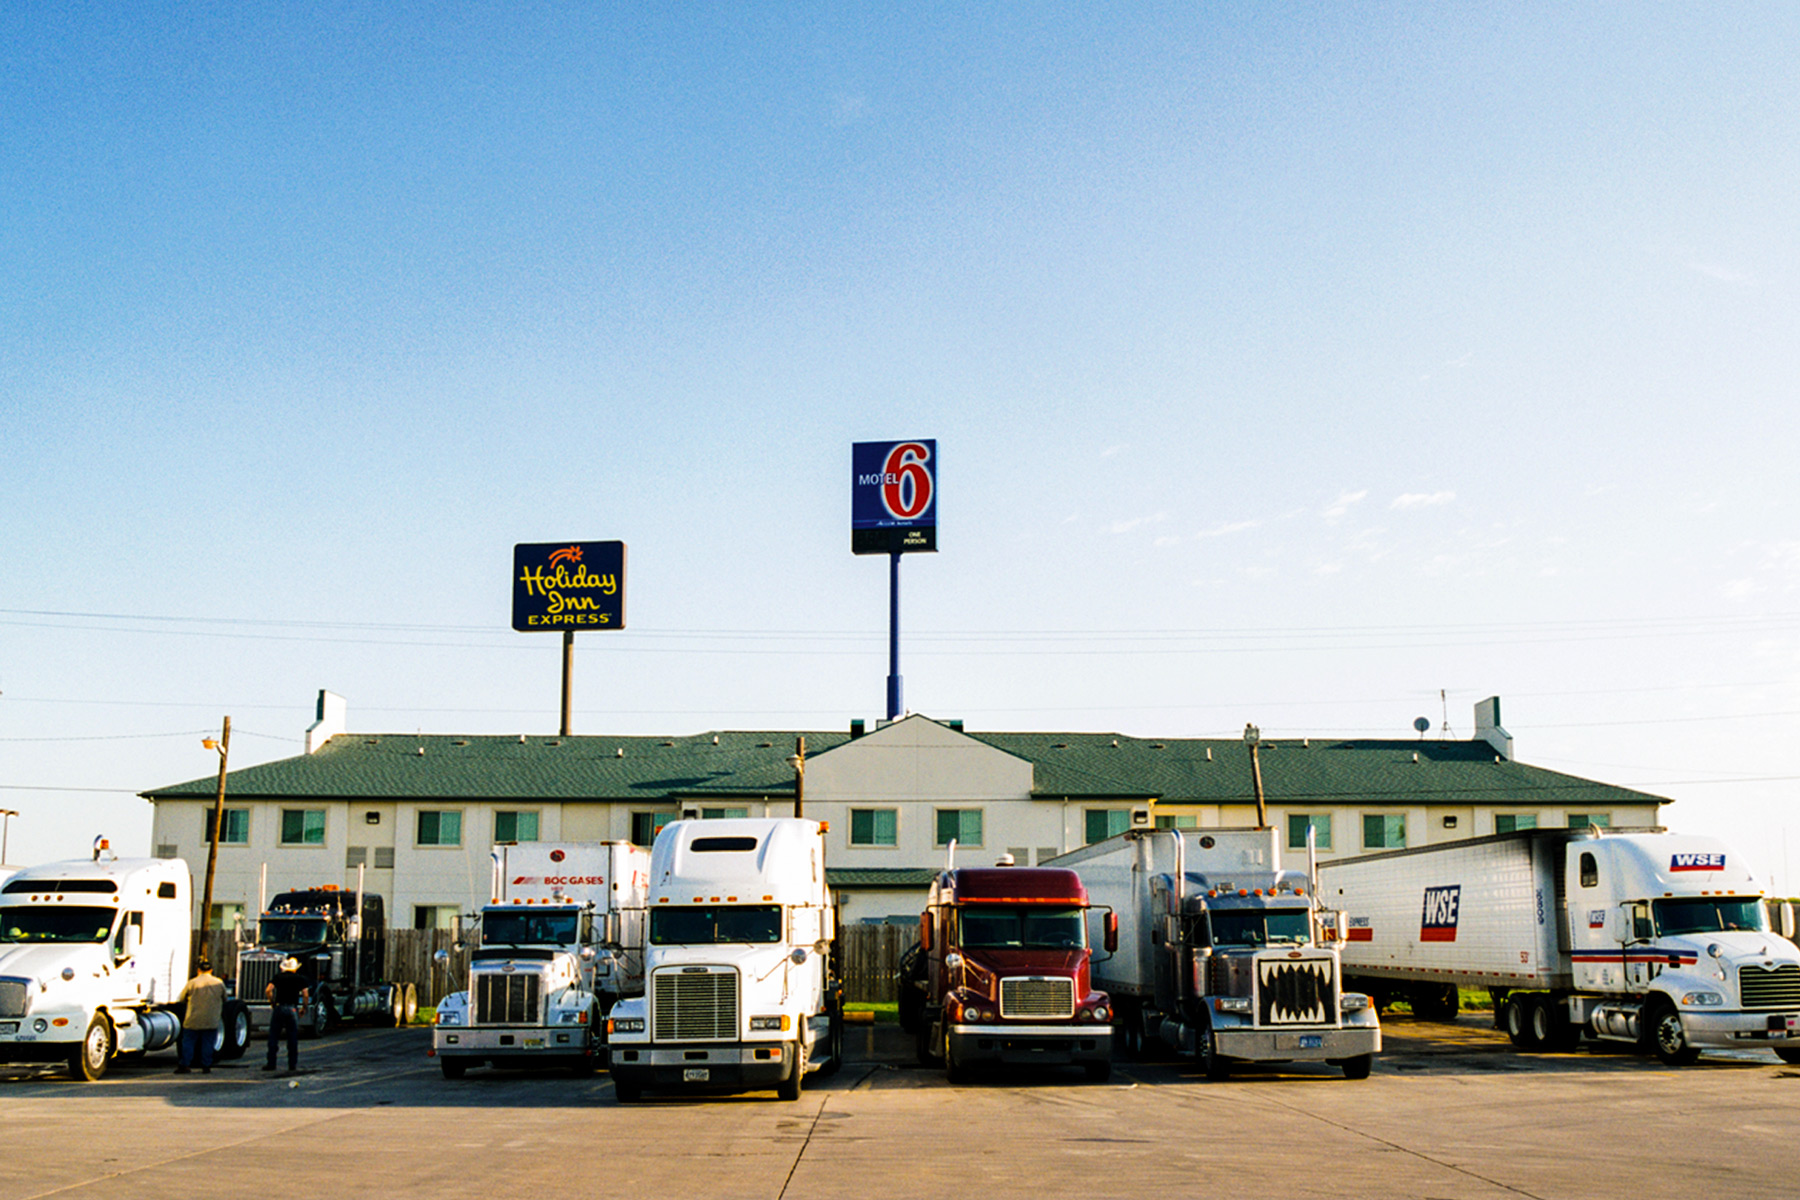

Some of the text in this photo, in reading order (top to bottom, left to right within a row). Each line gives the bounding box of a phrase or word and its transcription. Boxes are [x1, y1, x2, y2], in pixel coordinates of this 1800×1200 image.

[859, 442, 934, 520] MOTEL 6
[519, 563, 617, 596] Holiday
[547, 590, 600, 614] Inn
[528, 613, 610, 625] EXPRESS
[1676, 854, 1721, 866] WSE
[544, 876, 604, 885] BOC GASES
[1425, 889, 1459, 925] WSE
